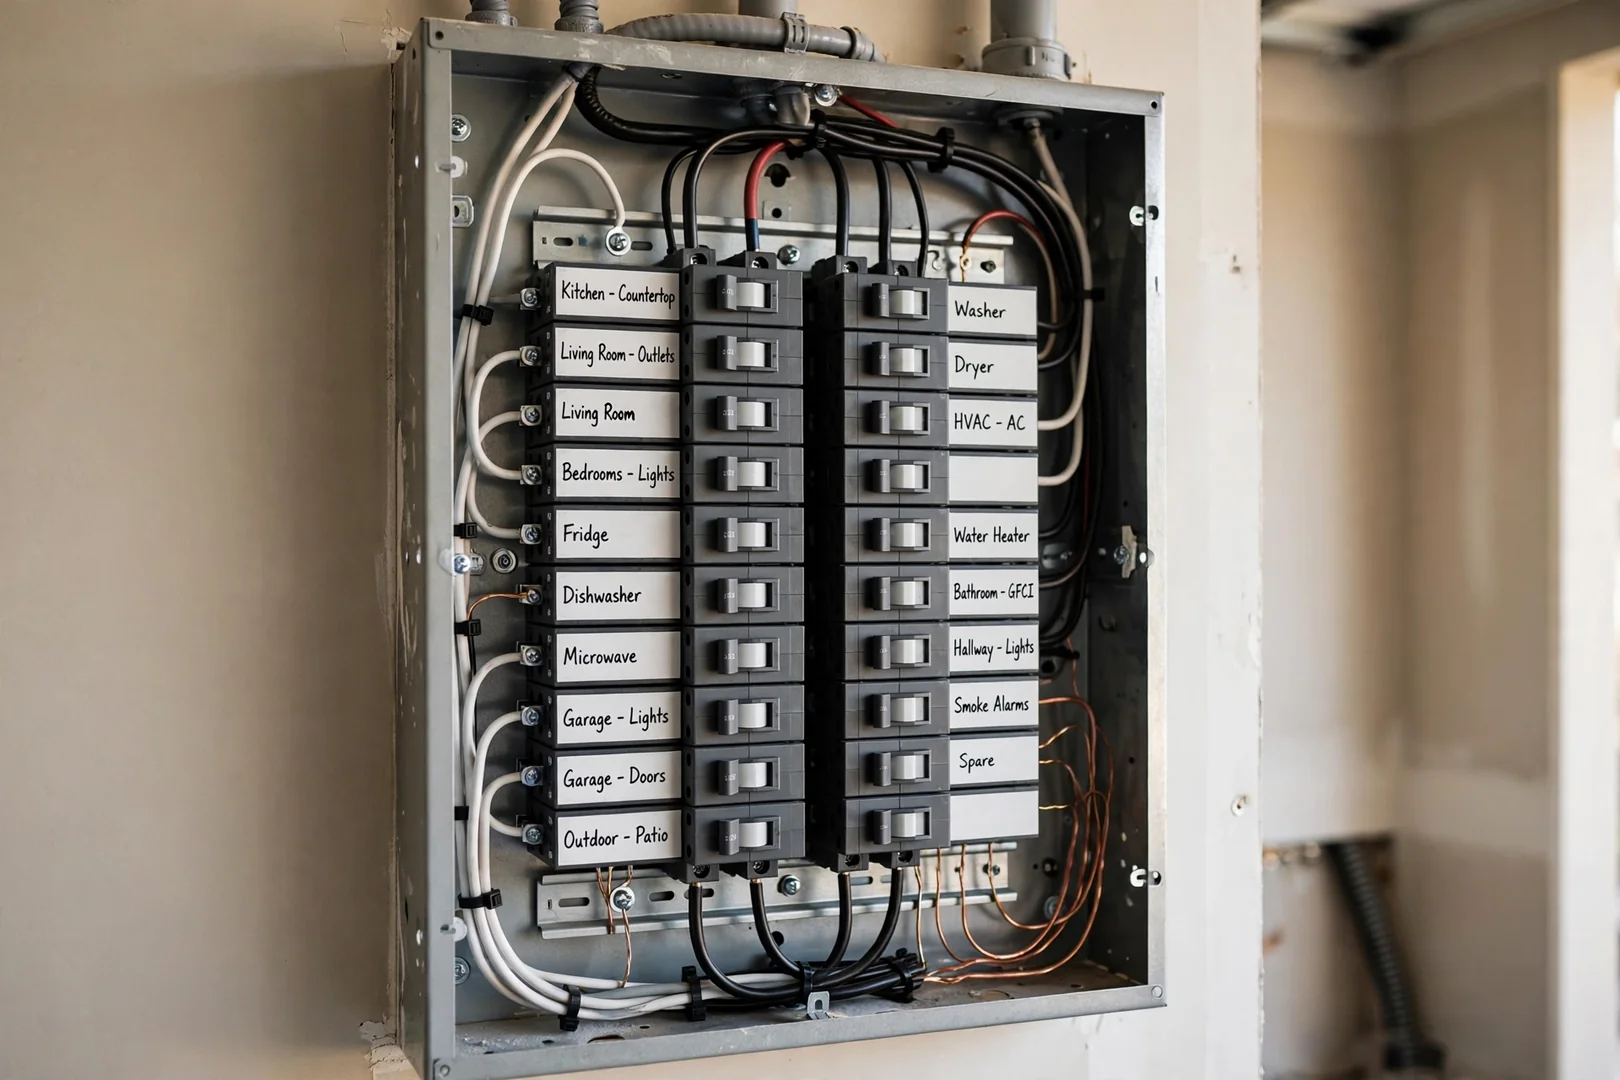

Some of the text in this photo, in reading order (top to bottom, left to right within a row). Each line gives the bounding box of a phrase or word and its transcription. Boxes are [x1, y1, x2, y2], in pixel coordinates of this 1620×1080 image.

[562, 280, 605, 300] Kitchen
[619, 284, 675, 309] Countertop
[955, 301, 1006, 318] Washer
[561, 342, 593, 367] Living
[599, 343, 626, 361] Room
[638, 345, 675, 364] Outlets
[955, 355, 994, 379] Dryer
[562, 402, 635, 427] Living Room
[955, 413, 991, 429] HVAC
[1007, 415, 1025, 430] AC
[563, 462, 622, 481] Bedrooms
[638, 464, 675, 488] Lights
[564, 523, 609, 549] Fridge
[954, 526, 1030, 543] Water Heater
[563, 585, 642, 604] Dishwasher
[954, 583, 998, 600] Bathroom
[1008, 583, 1034, 598] GFCI
[564, 646, 637, 665] Microwave
[954, 639, 993, 663] Hallway
[1006, 638, 1034, 661] Lights
[955, 695, 1029, 713] Smoke Alarms
[563, 708, 612, 733] Garage
[630, 706, 669, 731] Lights
[960, 753, 994, 773] Spare
[564, 769, 612, 793] Garage
[630, 766, 666, 784] Doors
[564, 829, 618, 849] Outdoor
[636, 825, 669, 845] Patio
